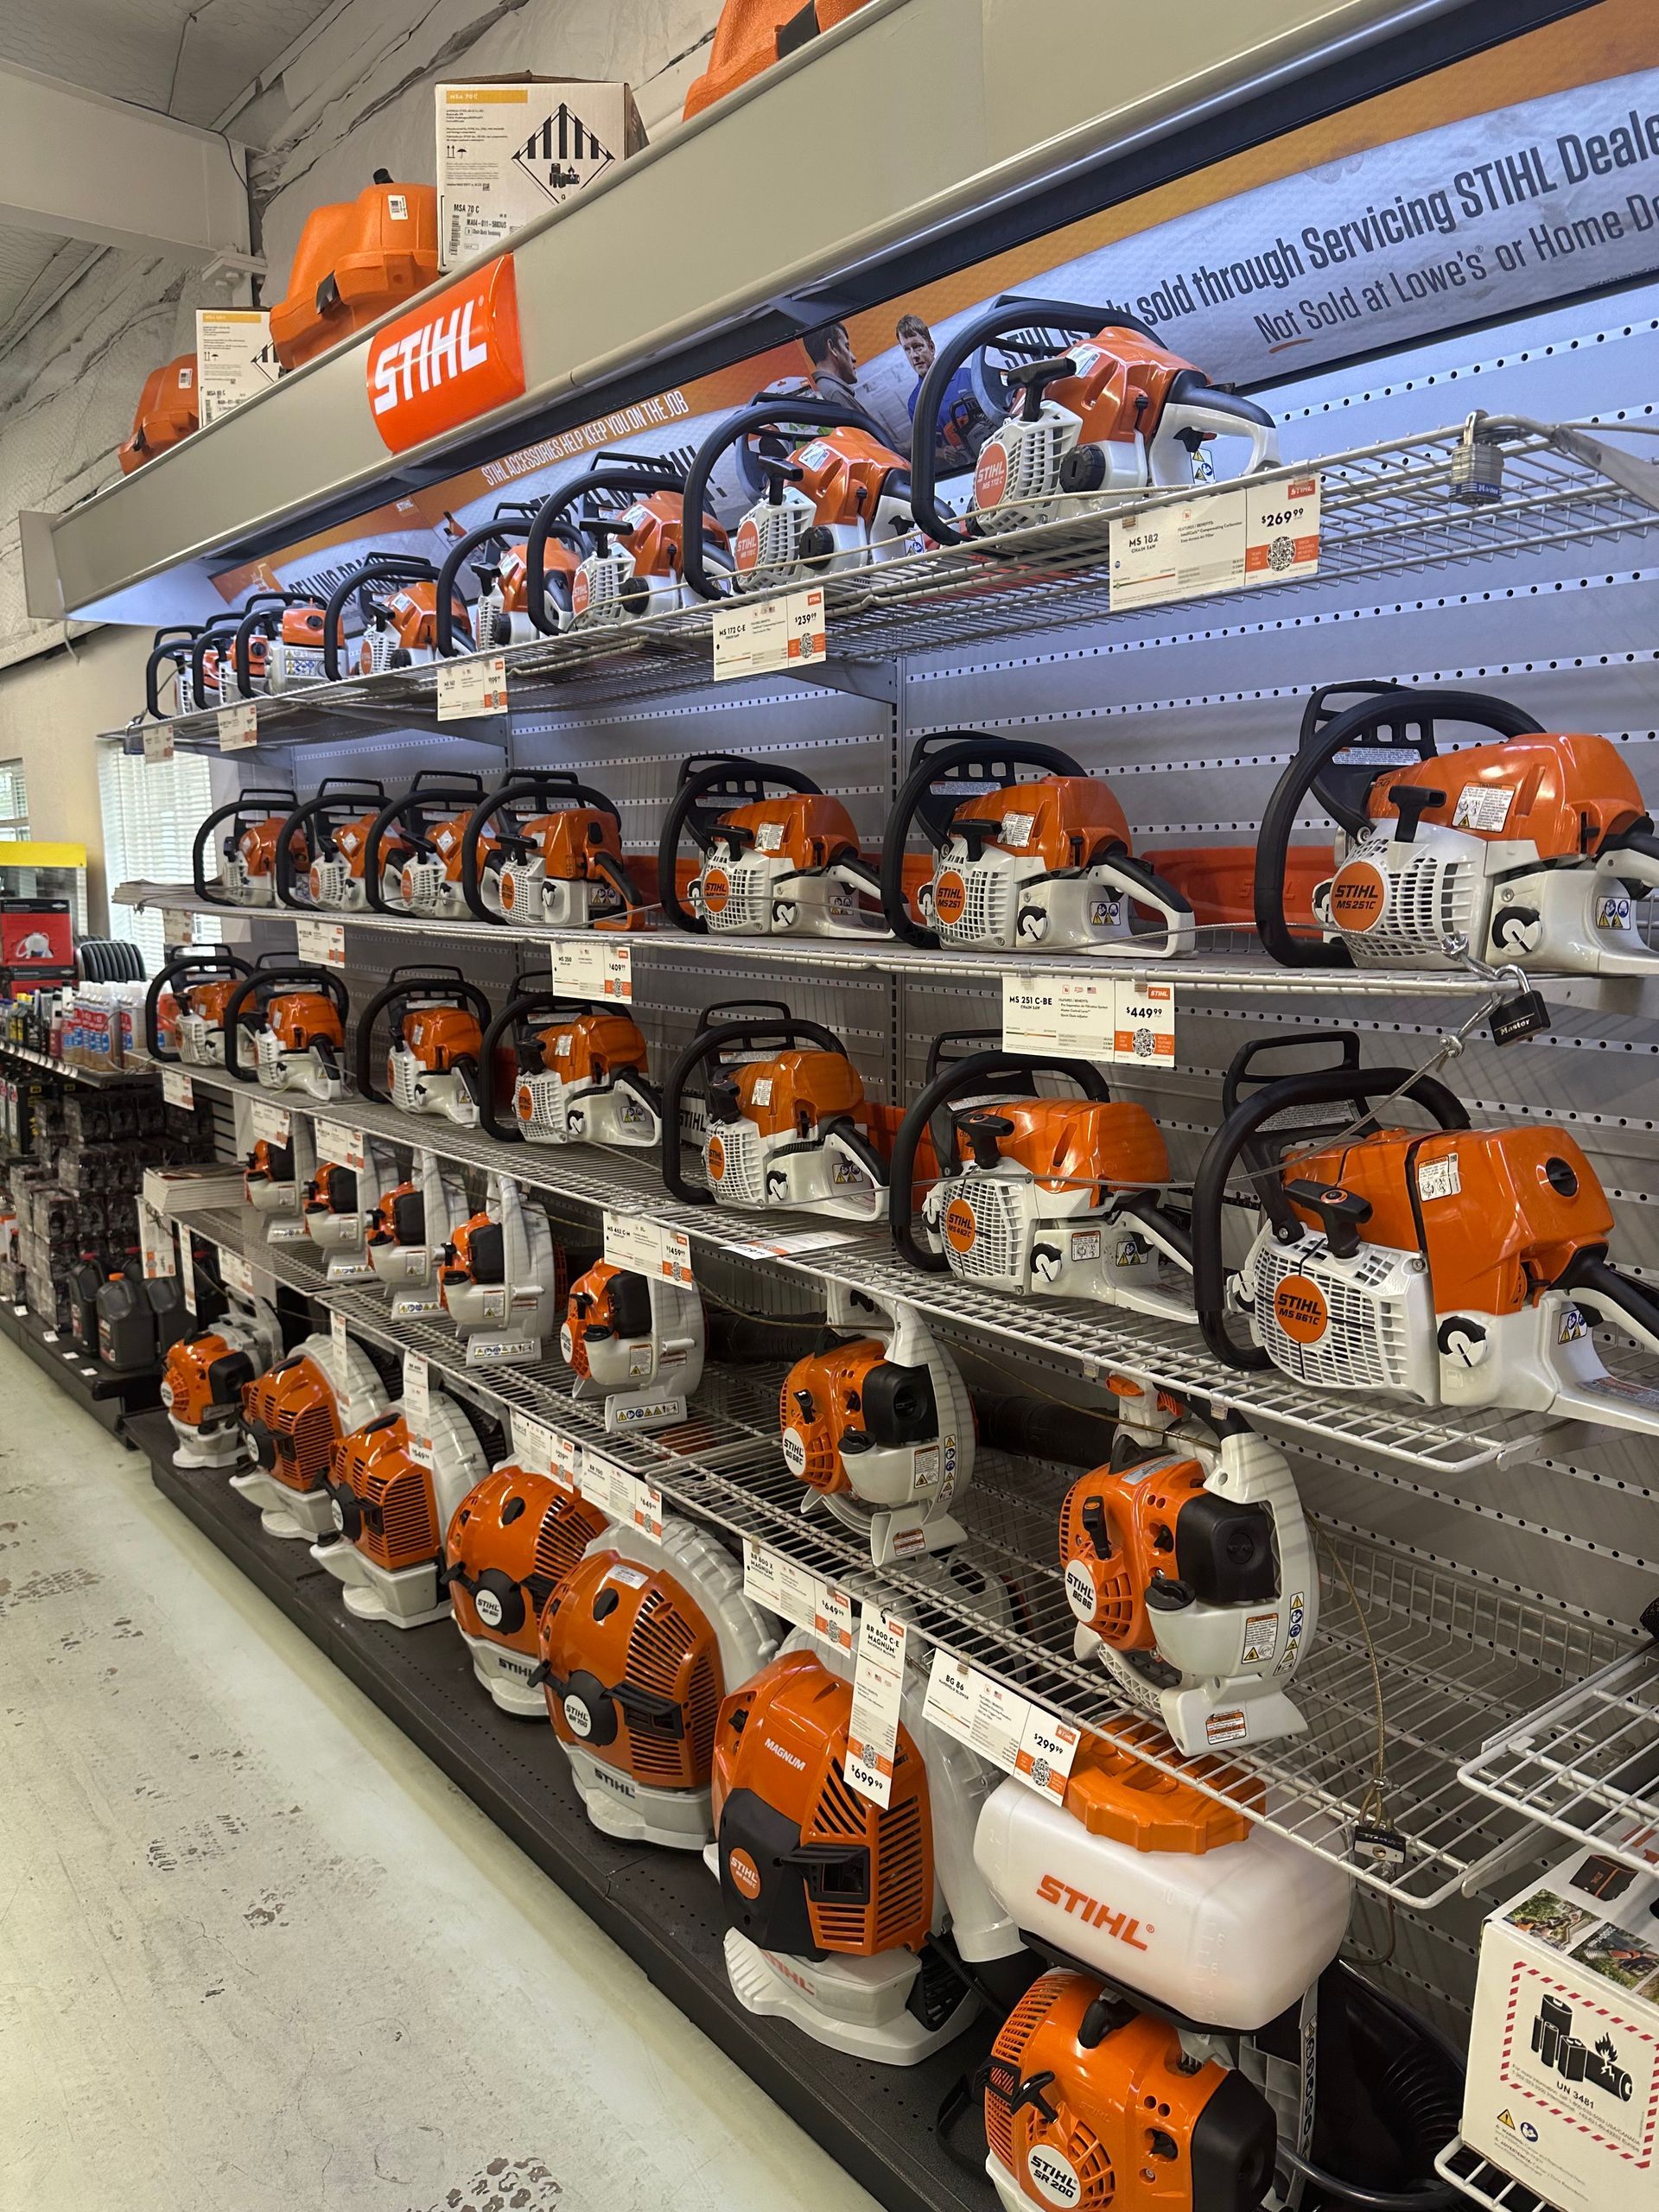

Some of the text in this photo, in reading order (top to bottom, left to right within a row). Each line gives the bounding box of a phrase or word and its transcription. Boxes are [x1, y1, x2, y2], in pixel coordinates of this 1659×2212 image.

[454, 203, 467, 213] MSA
[467, 205, 474, 213] 70
[1137, 270, 1198, 327] sold
[1197, 238, 1303, 308] through
[1301, 187, 1458, 270] Servicing
[1455, 148, 1558, 219] STIHL
[1254, 309, 1301, 344] Not
[1306, 285, 1357, 330] Sold
[1364, 282, 1386, 312] at
[1496, 242, 1524, 271] or
[1529, 211, 1624, 262] Home
[373, 301, 488, 416] STIHL
[480, 390, 690, 486] STIHL ACCESSORIES HELP KEEP YOU ON THE JOB
[977, 461, 1005, 483] STIHL
[397, 499, 414, 512] STIHL
[737, 536, 757, 551] STIHL
[1128, 533, 1159, 549] MS 182
[705, 882, 727, 892] STIHL
[938, 887, 962, 899] STIHL
[1335, 885, 1378, 898] STIHL
[1500, 1019, 1530, 1035] Master
[709, 1149, 722, 1160] STIHL
[948, 1213, 973, 1230] STIHL
[1278, 1293, 1322, 1315] STIHL
[784, 1438, 804, 1458] STIHL
[751, 1560, 773, 1576] MAGNUM
[1066, 1572, 1094, 1601] STIHL
[1072, 1589, 1083, 1603] BG
[478, 1599, 499, 1612] STIHL
[867, 1624, 874, 1634] BR
[875, 1630, 888, 1640] 800
[890, 1624, 903, 1635] STIHL
[868, 1634, 895, 1654] MAGNUM
[945, 1675, 964, 1691] BG 86
[566, 1704, 588, 1723] STIHL
[764, 1738, 807, 1771] MAGNUM
[594, 1767, 635, 1799] STIHL
[730, 1857, 758, 1884] STIHL
[1036, 1874, 1148, 1952] STIHL
[1557, 2081, 1595, 2108] UN 3481
[1031, 2155, 1077, 2191] STIHL
[1033, 2169, 1074, 2198] SR 200
